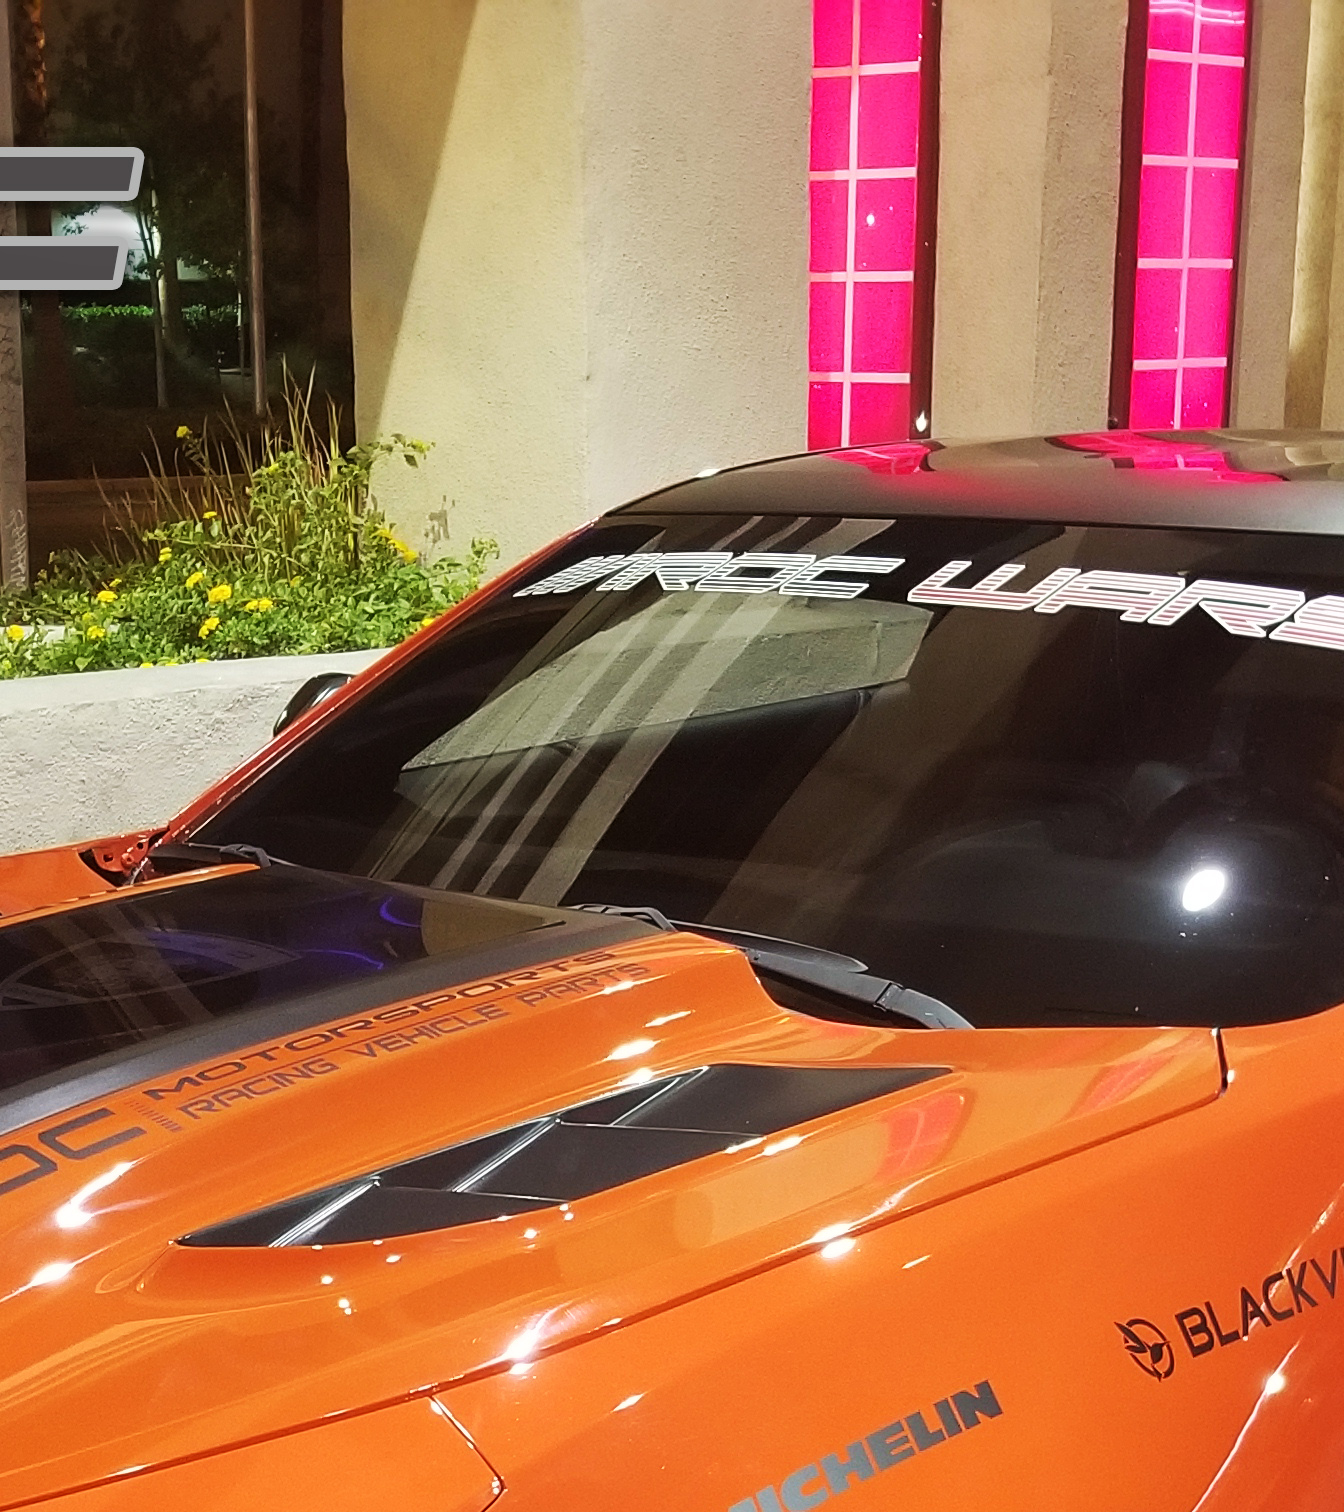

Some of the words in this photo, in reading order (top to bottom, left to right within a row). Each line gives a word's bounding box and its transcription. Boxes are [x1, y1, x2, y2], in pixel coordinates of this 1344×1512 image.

[143, 950, 615, 1100] MOTORSPORTS
[177, 1057, 341, 1120] RACING
[343, 1003, 510, 1059] VEHICLE
[516, 962, 651, 1008] PARTS
